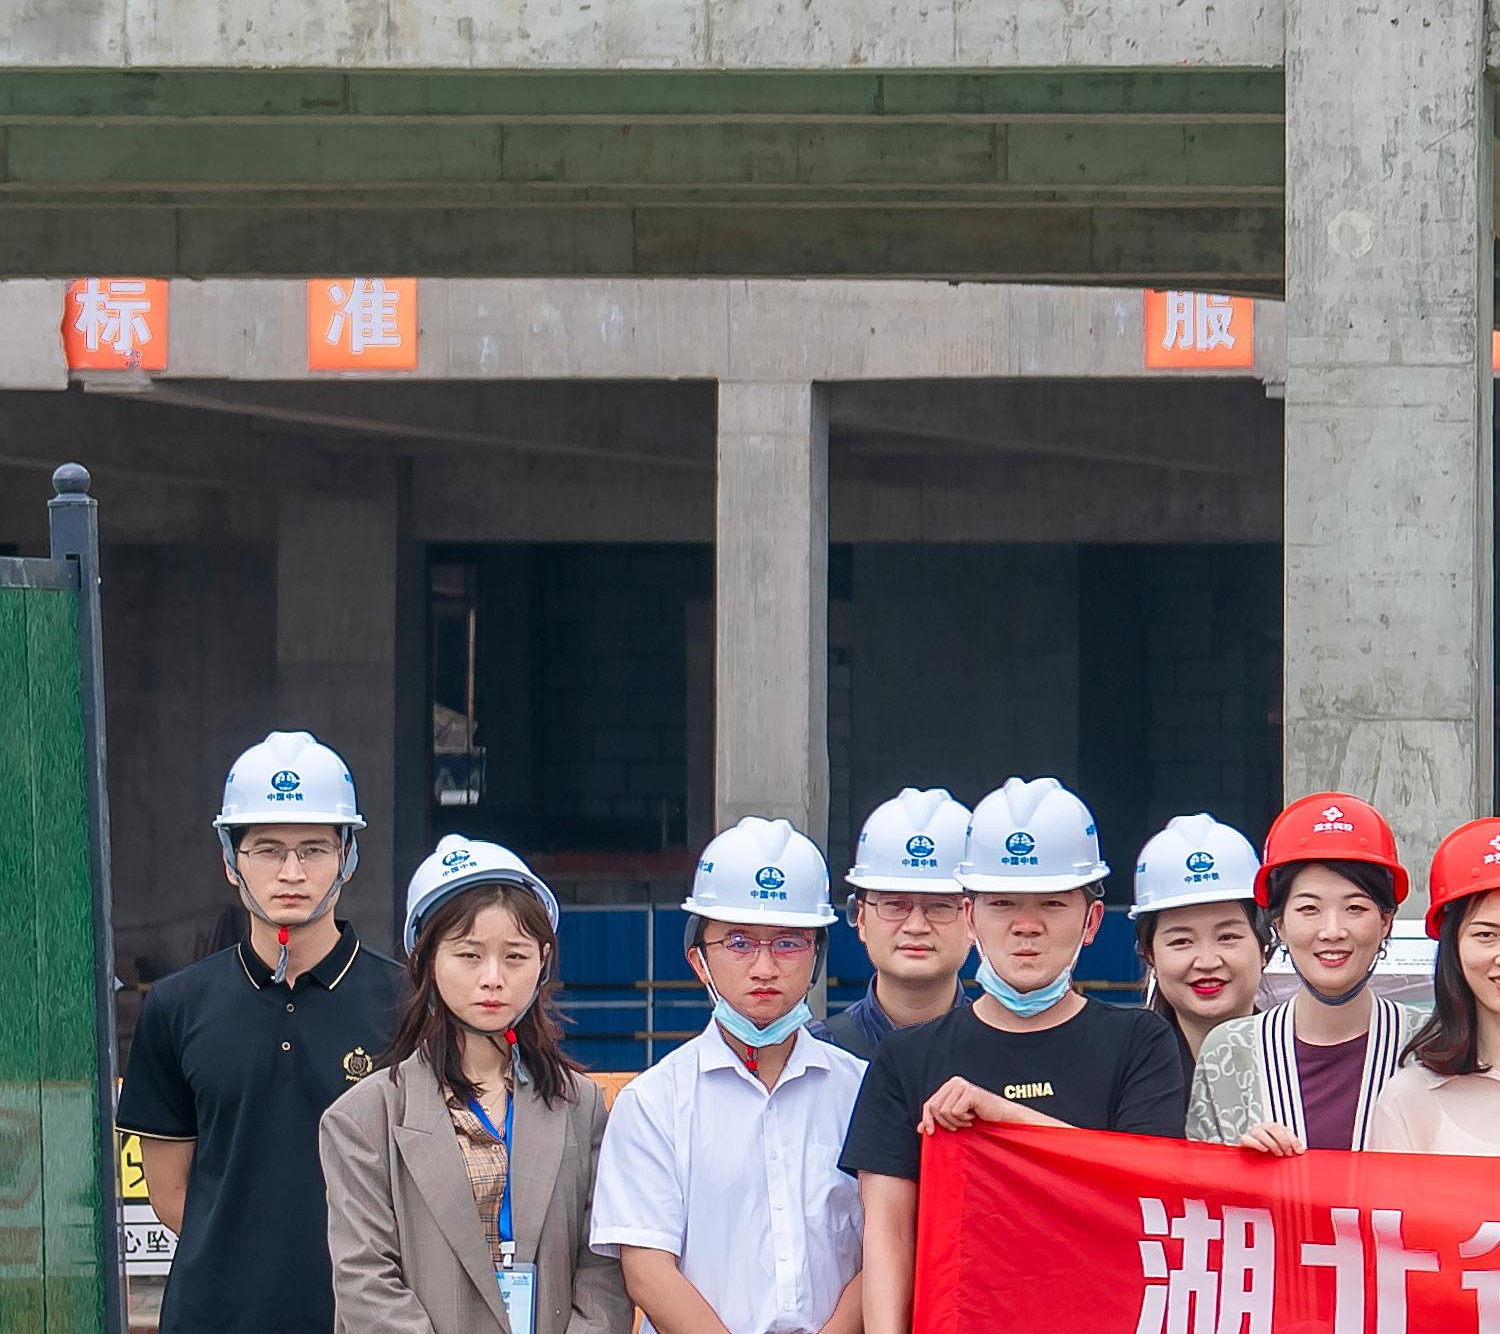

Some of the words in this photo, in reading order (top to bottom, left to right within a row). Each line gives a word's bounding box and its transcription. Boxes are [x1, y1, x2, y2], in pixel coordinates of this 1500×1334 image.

[74, 279, 153, 357] 标
[324, 278, 402, 354] 准
[1161, 290, 1238, 352] 服
[267, 792, 304, 802] 中国中铁
[901, 857, 938, 868] 中国中铁
[1001, 856, 1039, 866] 中国中铁
[749, 889, 788, 901] 中国中铁
[1003, 1080, 1054, 1101] CHINA
[125, 1230, 178, 1254] 心坠
